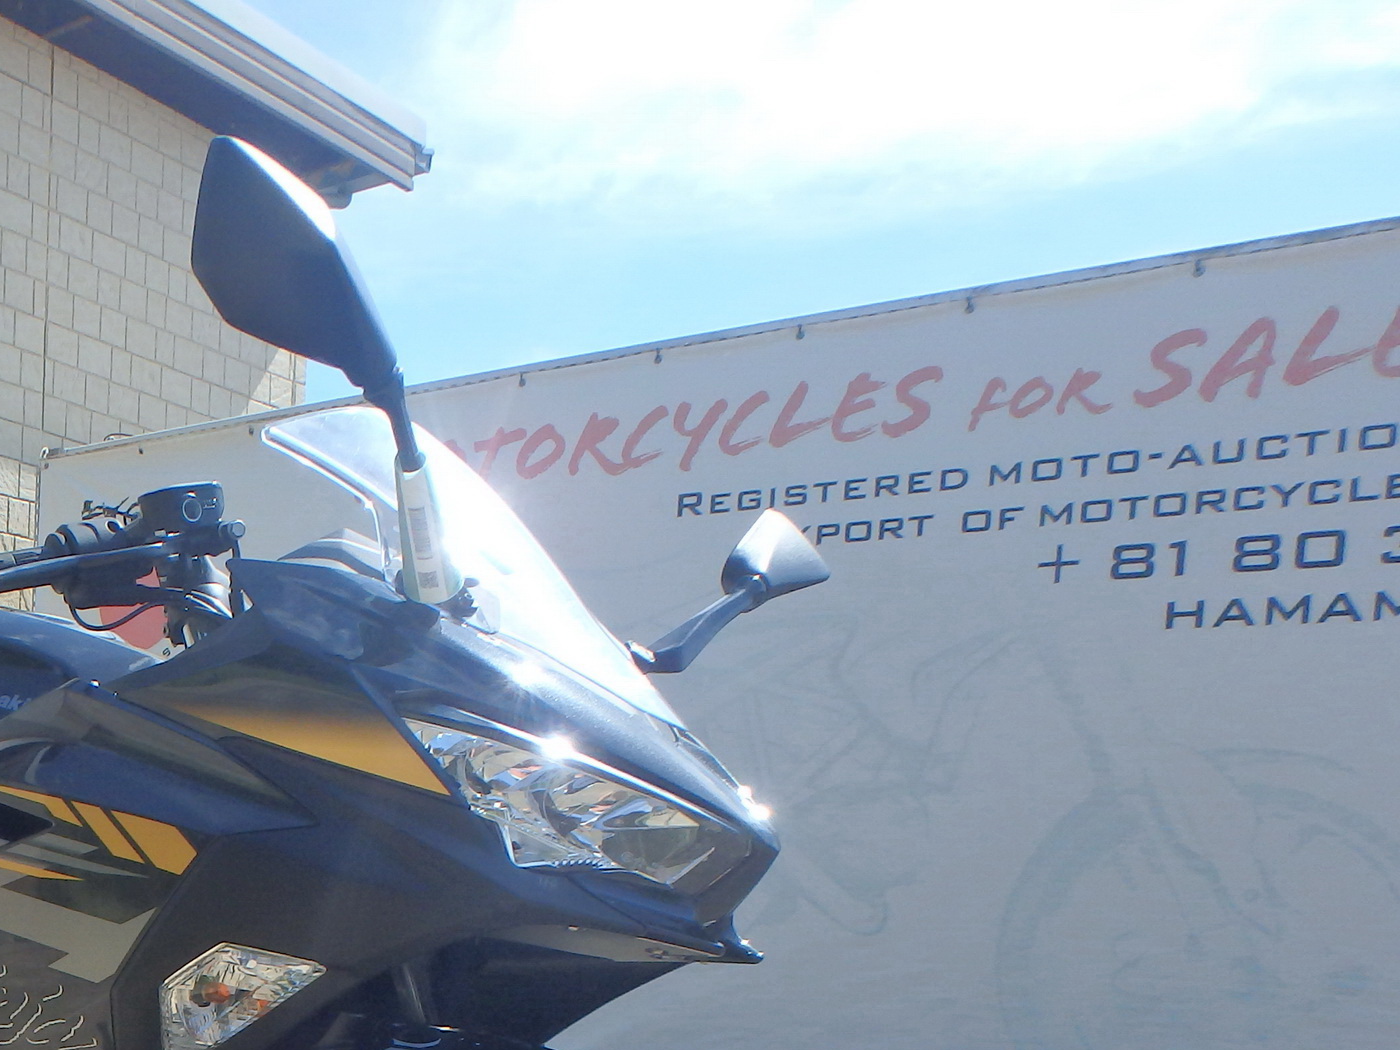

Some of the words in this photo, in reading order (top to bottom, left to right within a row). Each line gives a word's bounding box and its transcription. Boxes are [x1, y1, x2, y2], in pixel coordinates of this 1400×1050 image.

[968, 368, 1113, 431] FOR
[676, 467, 969, 517] REGISTERED
[988, 423, 1398, 487] MOTO-AUCTIO
[801, 514, 935, 546] PORT
[961, 505, 1025, 534] OF
[1232, 529, 1347, 573] 80
